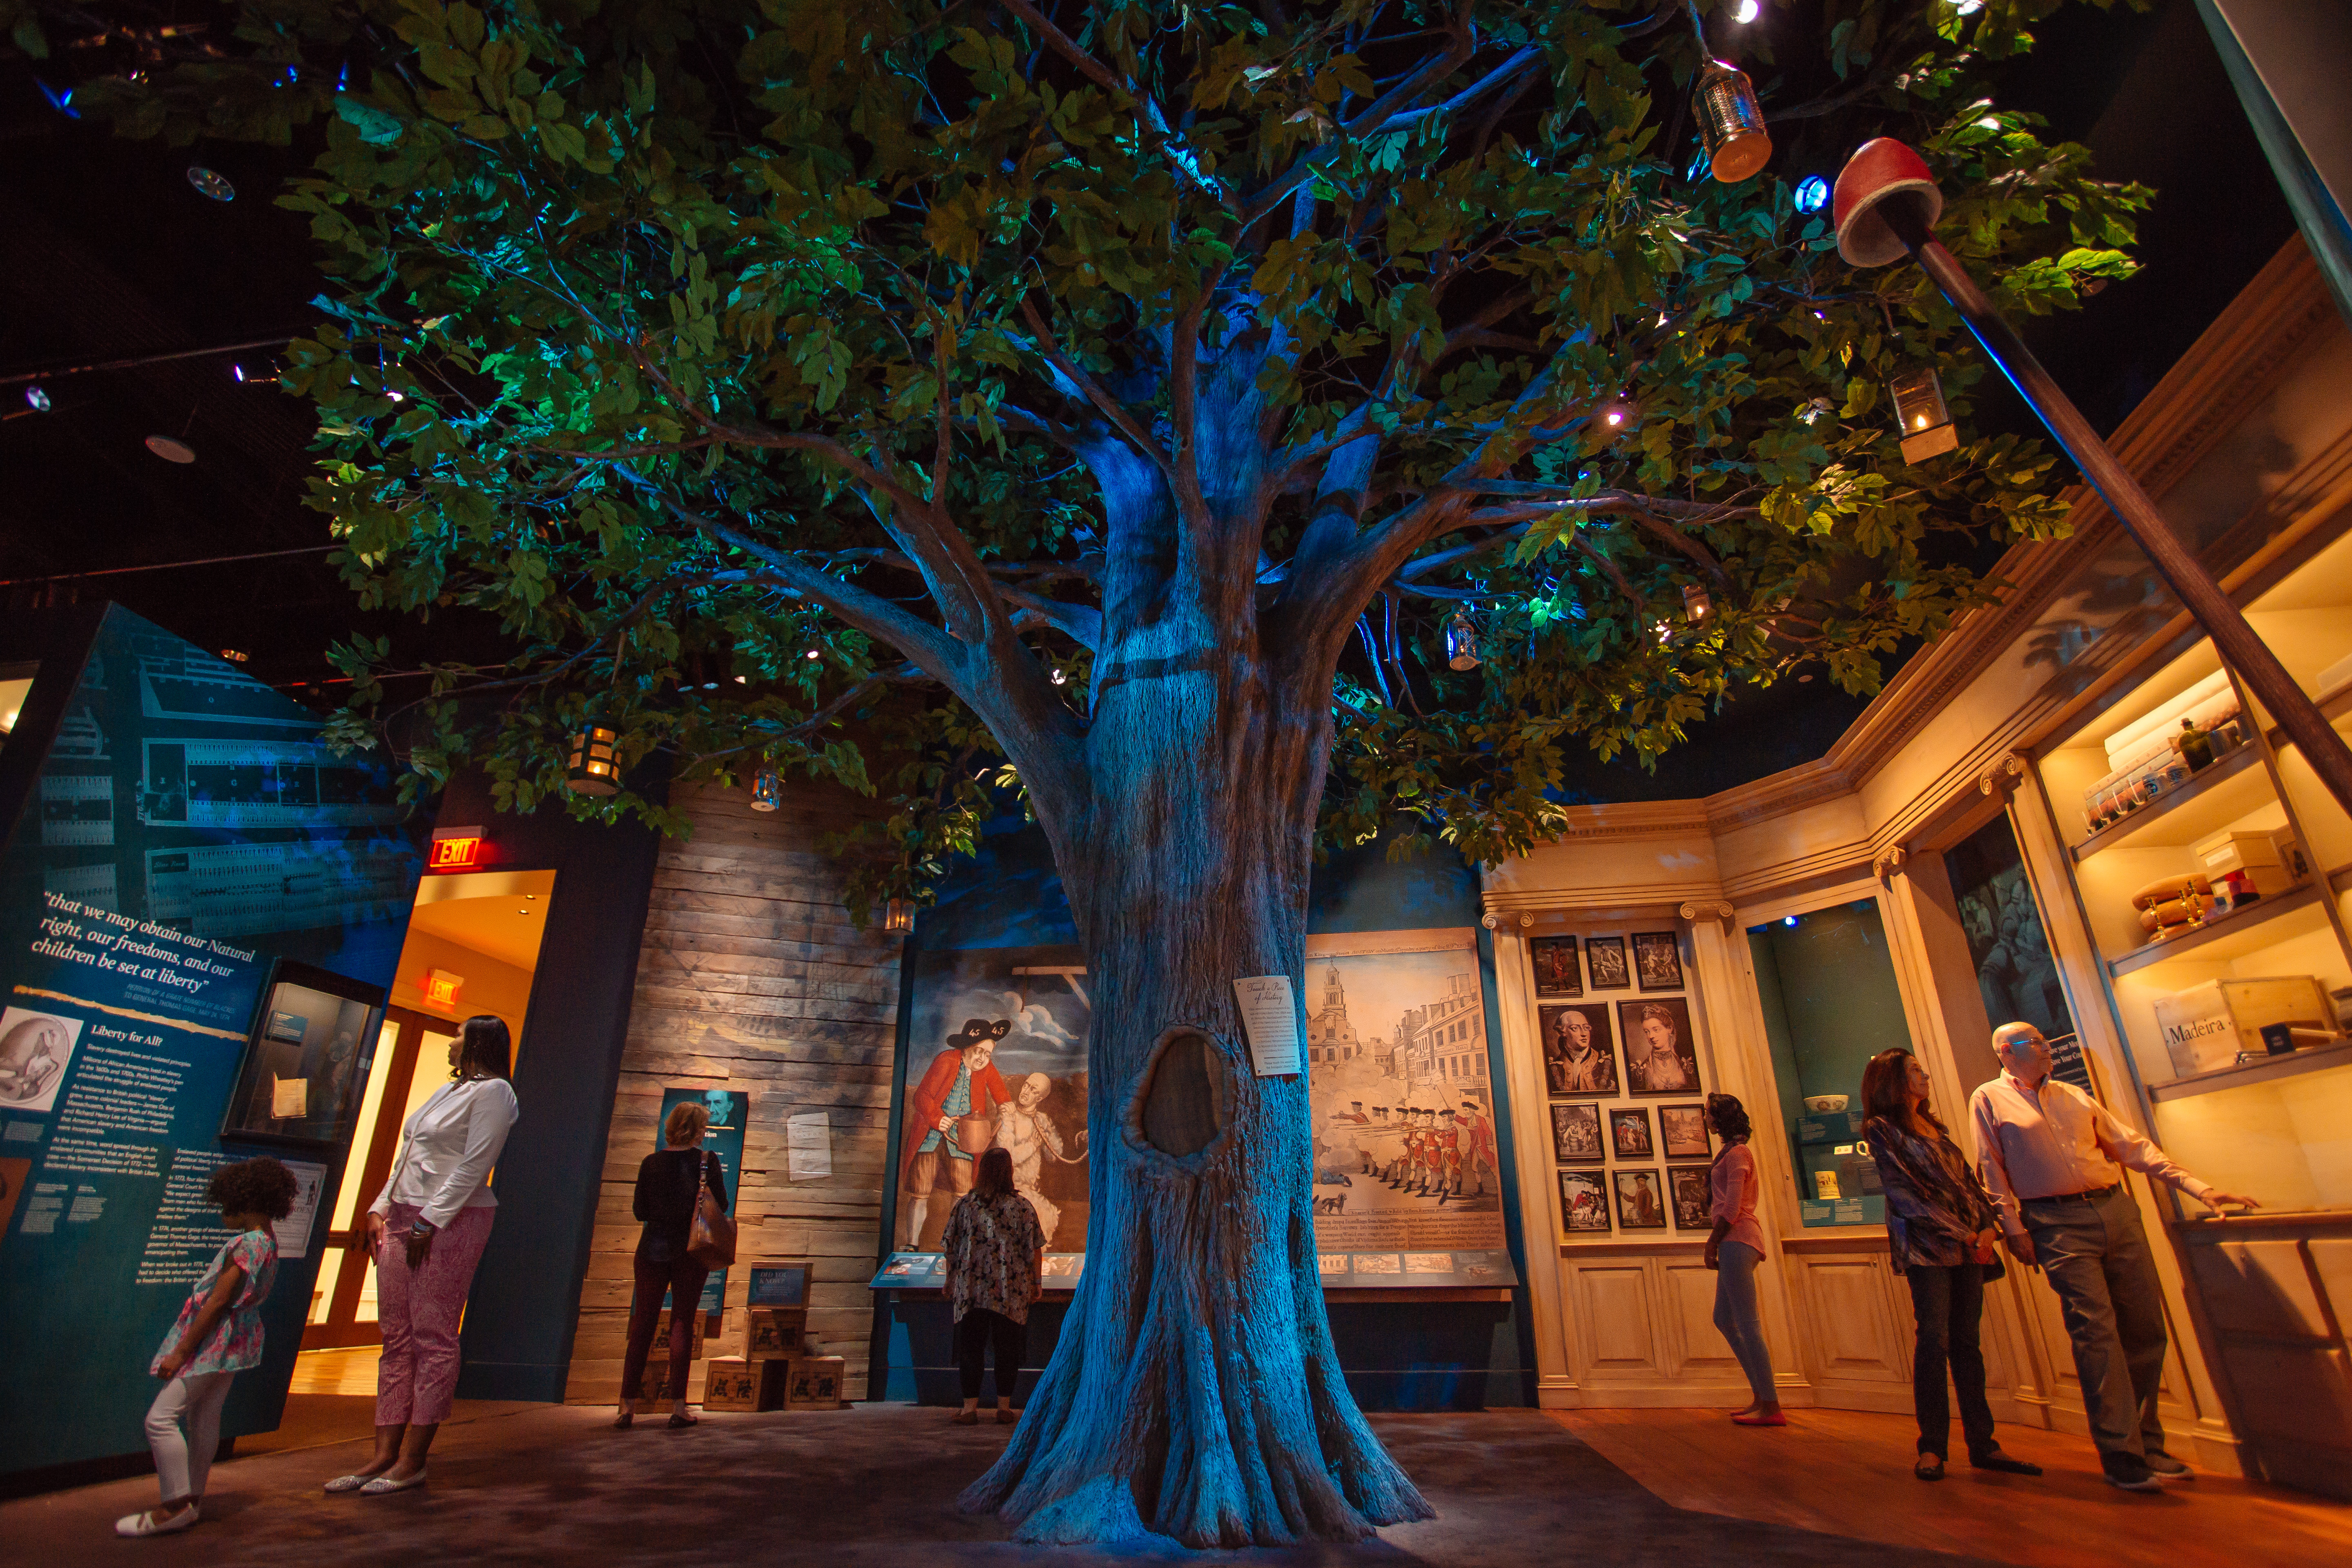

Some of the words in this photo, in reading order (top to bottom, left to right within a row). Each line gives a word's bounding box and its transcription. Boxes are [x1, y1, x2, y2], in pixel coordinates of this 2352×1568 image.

[439, 841, 472, 863] EXIT
[84, 906, 105, 920] we
[105, 912, 138, 932] may
[138, 920, 182, 942] obtain
[183, 935, 207, 949] our
[206, 940, 256, 962] Natural
[40, 916, 82, 940] right,
[86, 931, 116, 945] our
[111, 934, 180, 966] freedoms,
[184, 958, 212, 972] and
[210, 964, 234, 977] our
[31, 938, 96, 965] children
[96, 952, 117, 970] be
[116, 962, 140, 976] set
[140, 968, 158, 980] at
[157, 968, 210, 993] liberty”
[434, 983, 453, 1000] EXIT
[1247, 980, 1265, 992] Touch
[1254, 992, 1261, 1004] of
[1262, 991, 1283, 1004] History
[91, 1025, 128, 1041] Liberty
[128, 1031, 144, 1042] for
[143, 1035, 163, 1047] All?
[2168, 1018, 2225, 1045] Madeira
